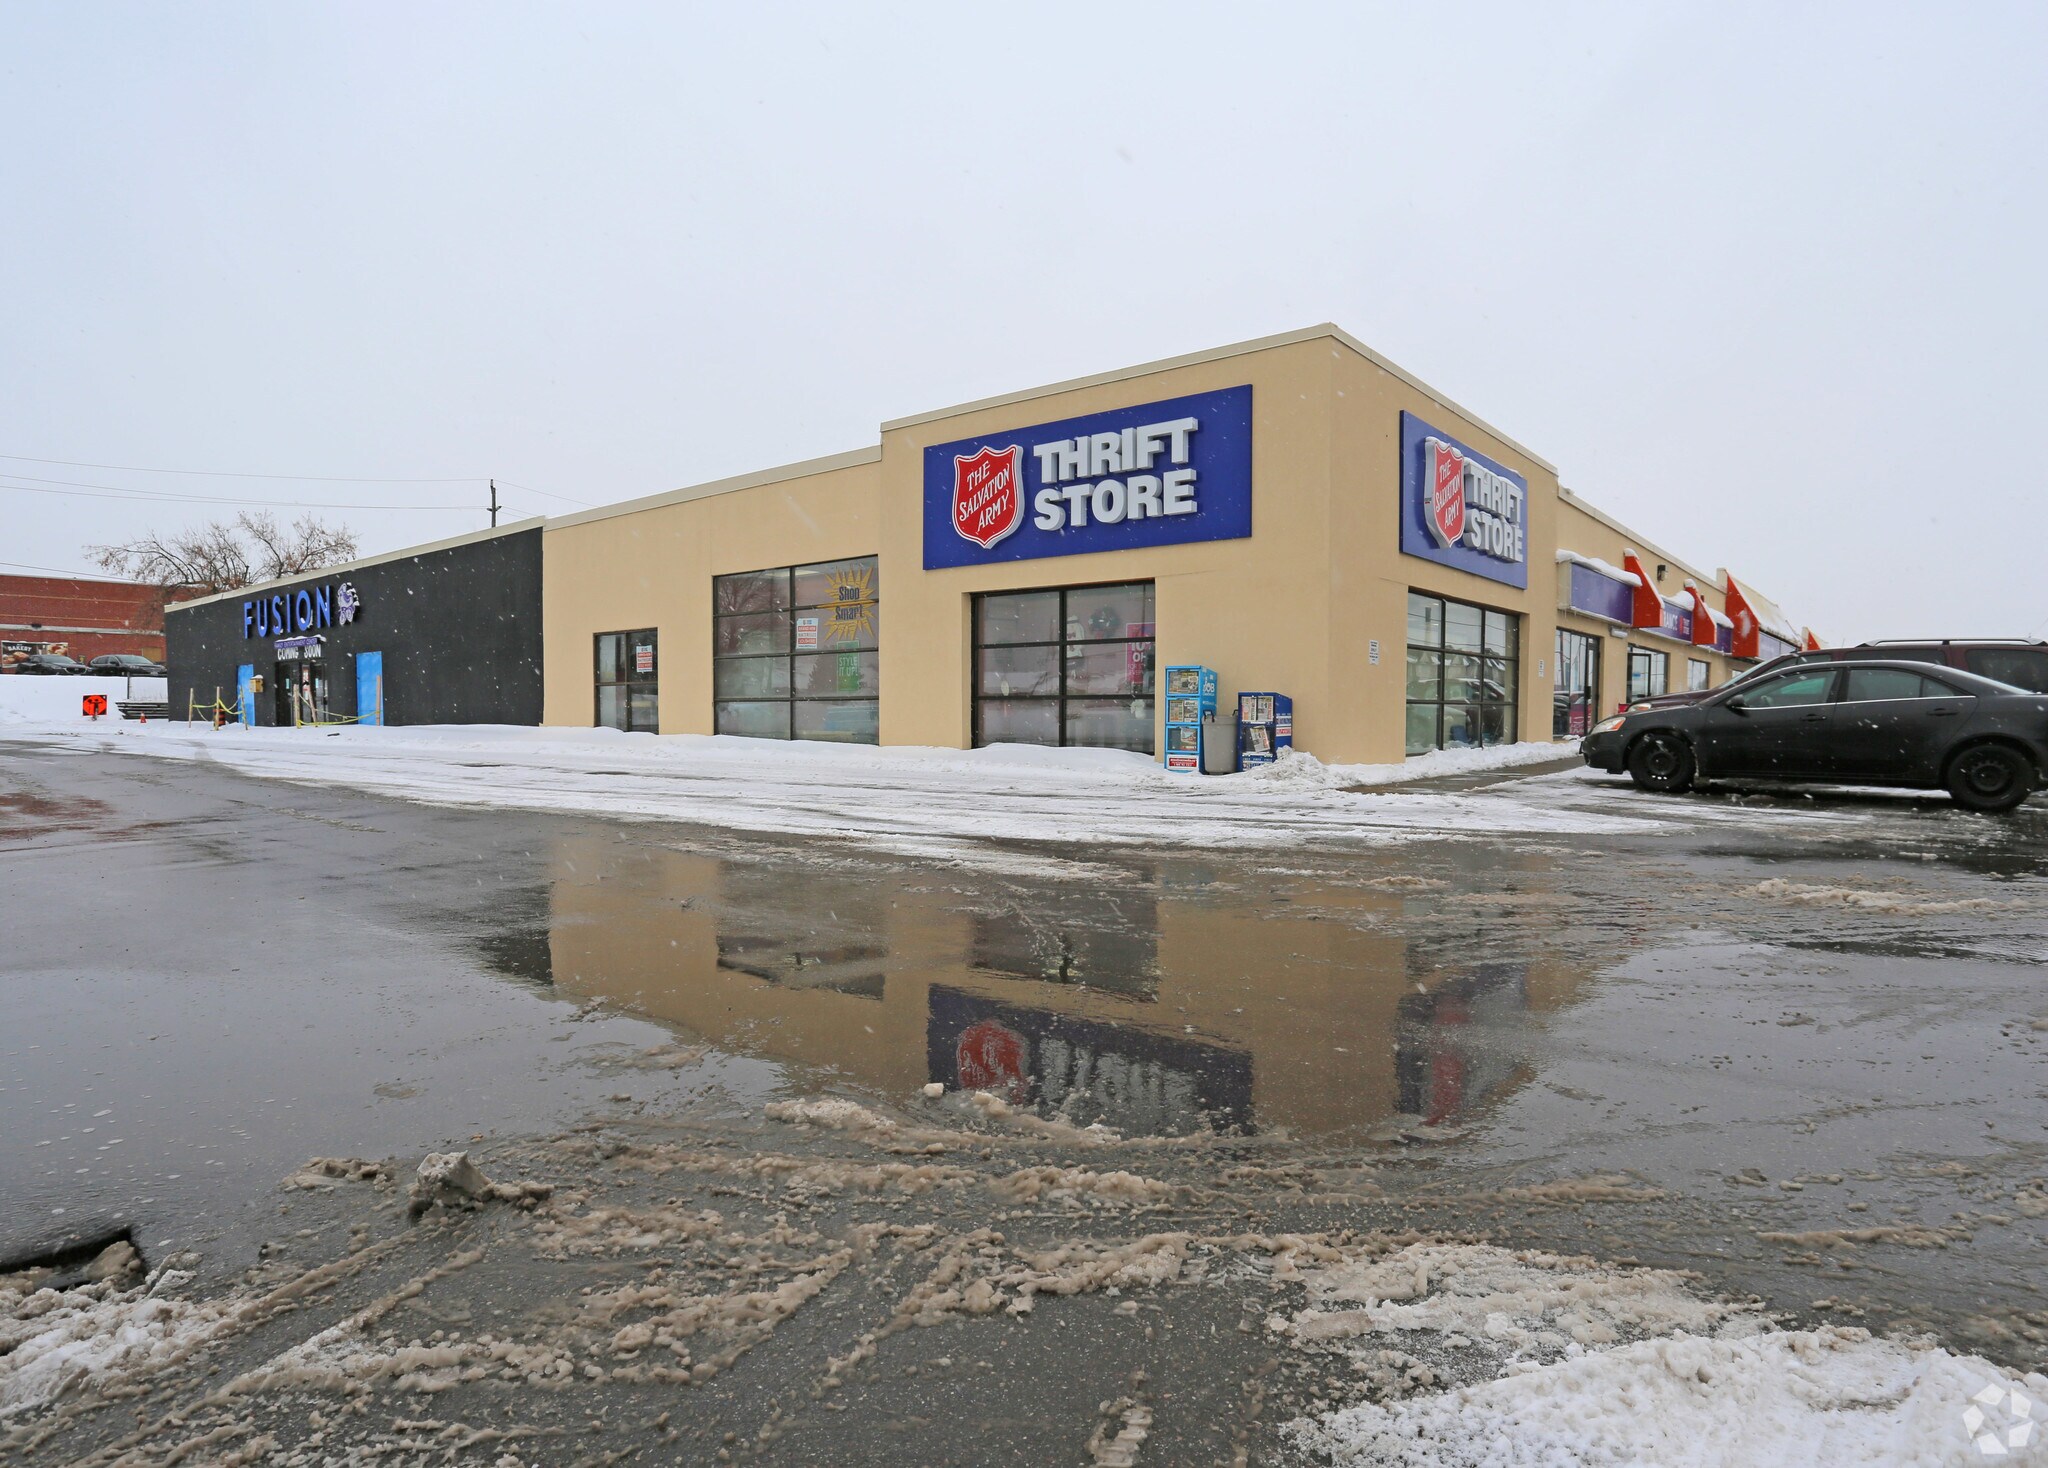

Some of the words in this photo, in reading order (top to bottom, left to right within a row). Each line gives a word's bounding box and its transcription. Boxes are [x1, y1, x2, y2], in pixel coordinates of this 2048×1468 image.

[1034, 417, 1198, 484] THRIFT
[967, 460, 991, 492] THE
[1439, 459, 1452, 484] THE
[959, 463, 1011, 521] SALVATION
[977, 488, 1011, 533] ARMY
[1034, 468, 1198, 531] STORE
[1435, 471, 1461, 513] SALVATION
[1465, 463, 1523, 524] THRIFT
[1444, 496, 1461, 530] ARMY
[1463, 508, 1524, 563] STORE
[244, 585, 331, 639] FUSION
[835, 604, 864, 621] Smart
[838, 586, 860, 601] Shop
[278, 647, 298, 660] COMING
[304, 645, 321, 658] SOON
[839, 657, 858, 666] STYLE
[839, 667, 844, 677] IT
